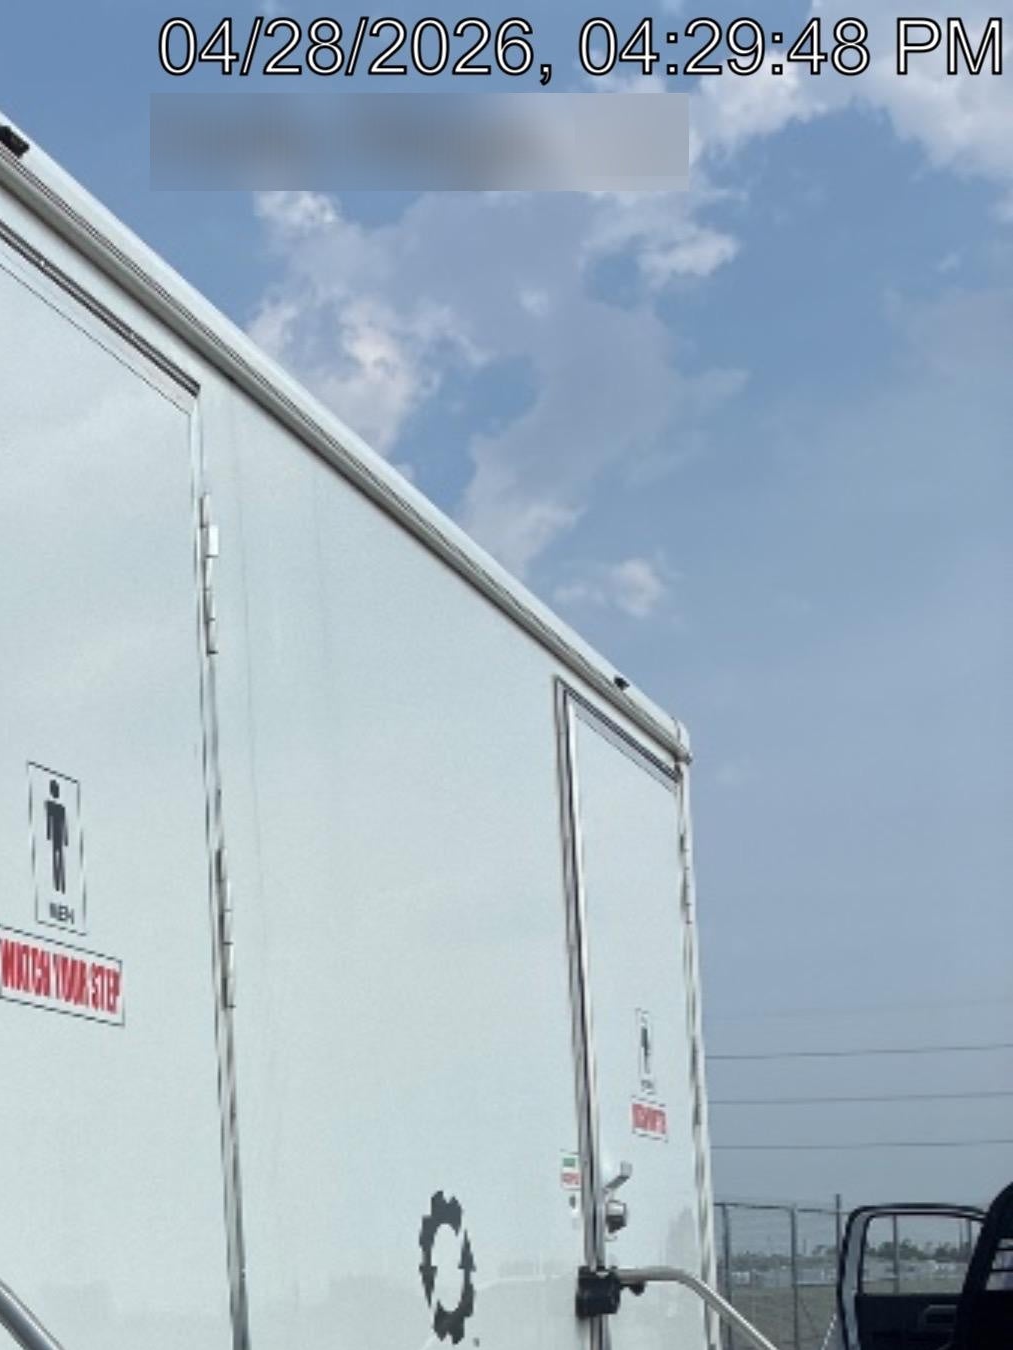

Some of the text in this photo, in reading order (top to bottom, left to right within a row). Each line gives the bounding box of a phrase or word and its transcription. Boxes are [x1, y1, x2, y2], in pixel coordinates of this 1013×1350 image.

[0, 938, 121, 1014] WATCH YOUR STEP
